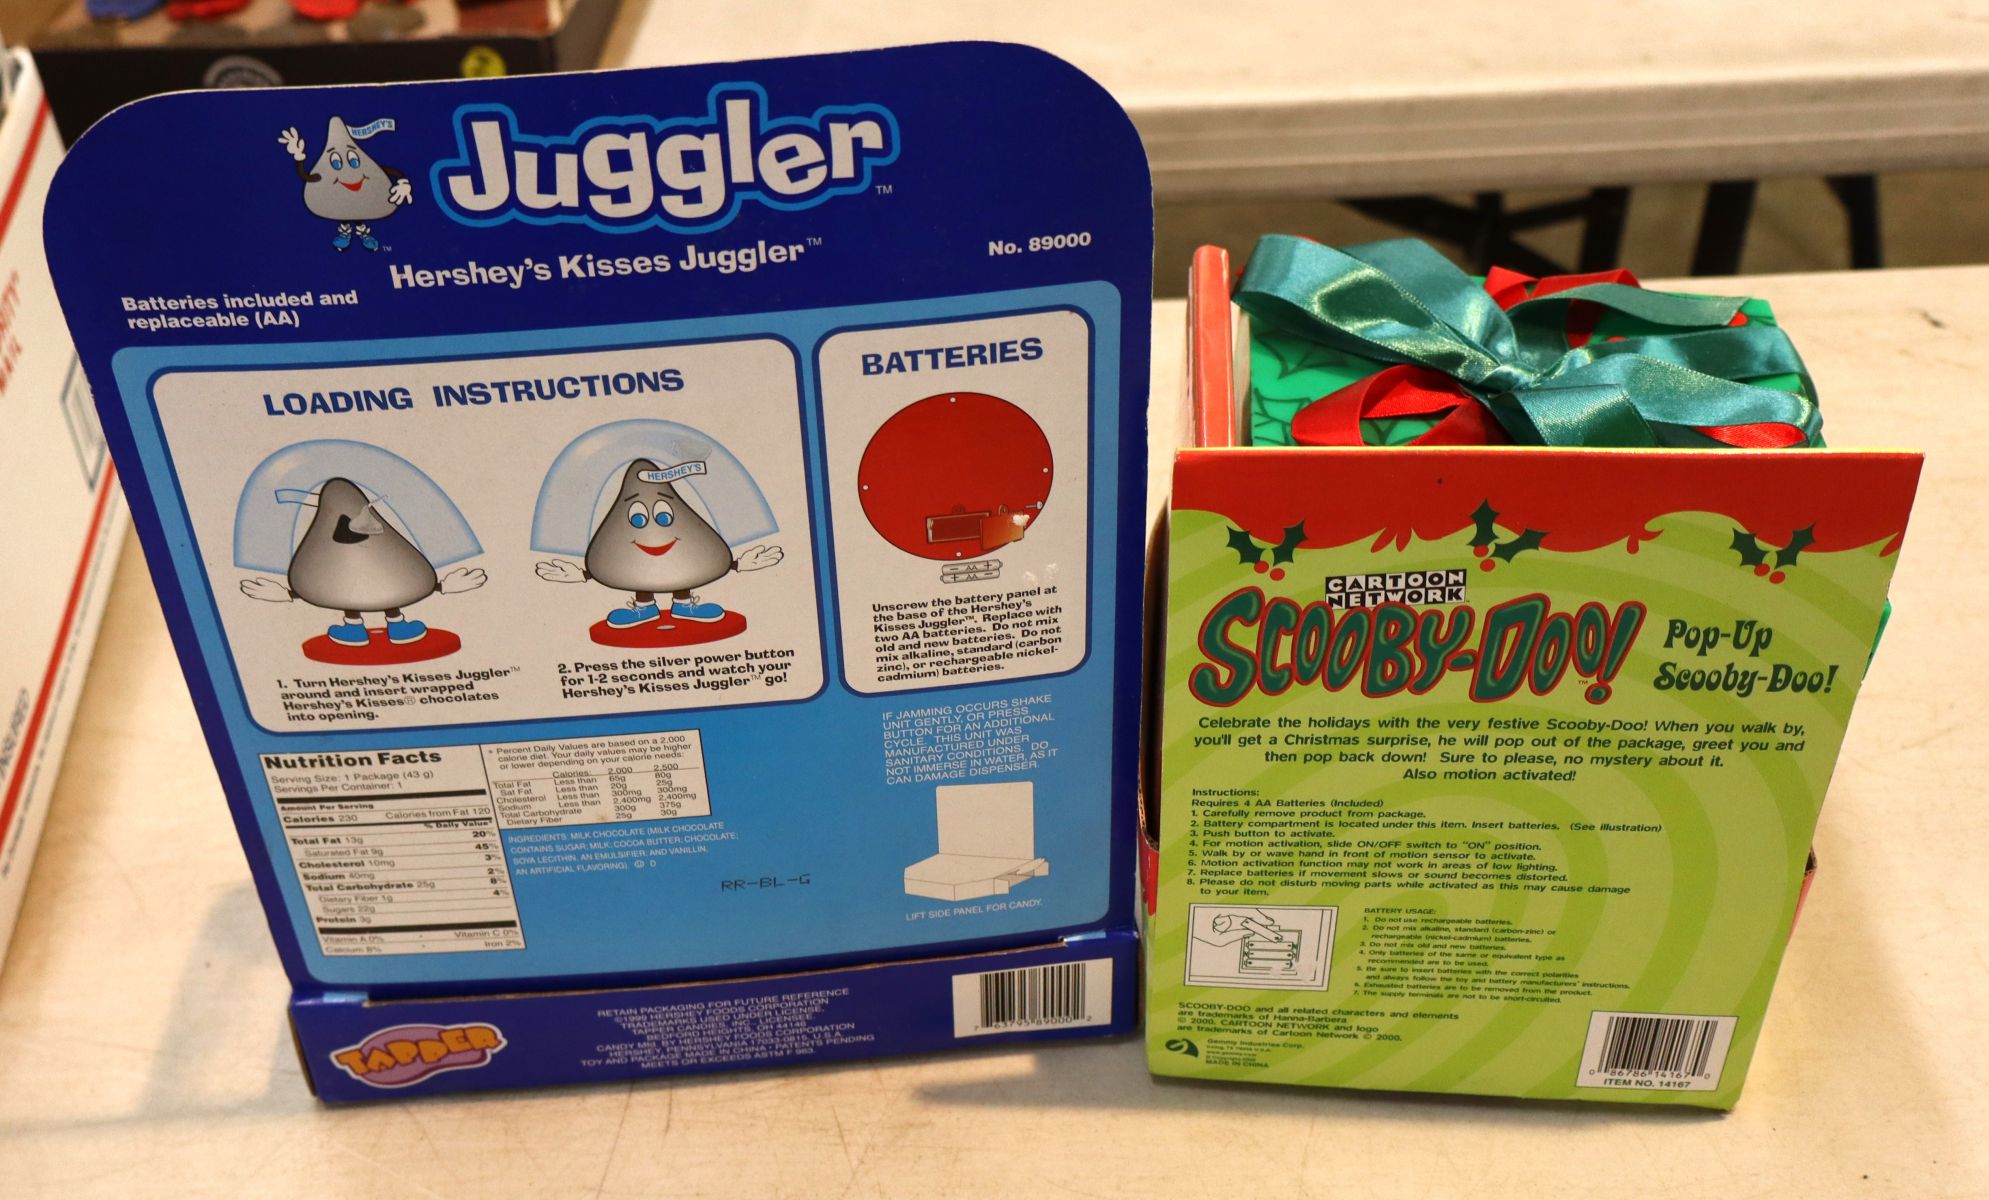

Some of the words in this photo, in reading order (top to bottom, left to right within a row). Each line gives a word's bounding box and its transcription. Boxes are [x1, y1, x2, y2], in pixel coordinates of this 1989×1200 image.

[448, 99, 883, 218] Juggler
[988, 240, 1022, 256] No.
[1028, 231, 1092, 253] 89000
[389, 257, 553, 291] Hershey's
[559, 251, 672, 281] Kisses
[121, 295, 219, 313] Batteries
[223, 292, 314, 310] included
[319, 290, 359, 306] and
[127, 312, 250, 333] replaceable
[254, 309, 301, 330] (AA)
[860, 336, 1044, 377] BATTERIES
[263, 387, 413, 417] LOADING
[431, 368, 685, 410] INSTRUCTIONS
[647, 463, 702, 481] HERSHEY'S
[1326, 569, 1466, 593] CARTOON
[871, 600, 929, 613] Unscrew
[930, 596, 952, 607] the
[953, 592, 1004, 605] battery
[1005, 585, 1041, 602] panel
[1042, 584, 1058, 595] at
[1326, 589, 1466, 609] NETWORK
[871, 612, 894, 623] the
[895, 610, 928, 621] base
[929, 606, 945, 618] of
[946, 605, 968, 616] the
[969, 597, 1033, 614] Hershey's
[1189, 586, 1647, 707] SCOOBY-DOO!
[1663, 618, 1773, 657] Pop-Up
[556, 662, 572, 674] 2.
[572, 661, 619, 673] Press
[619, 657, 646, 670] the
[647, 655, 691, 668] silver
[693, 652, 742, 668] power
[743, 647, 795, 661] button
[275, 678, 288, 689] 1.
[291, 677, 328, 689] Turn
[327, 673, 400, 688] Hershey's
[401, 672, 452, 683] Kisses
[559, 674, 585, 687] for
[586, 672, 608, 685] 1-2
[609, 667, 675, 683] seconds
[676, 664, 706, 678] and
[707, 661, 755, 676] watch
[756, 661, 792, 675] your
[560, 683, 636, 699] Hershey's
[637, 681, 690, 694] Kisses
[763, 670, 788, 687] go!
[1653, 661, 1840, 698] Scooby-Doo!
[279, 687, 332, 700] around
[333, 686, 361, 698] and
[362, 685, 408, 697] insert
[408, 679, 475, 695] wrapped
[281, 698, 354, 712] Hershey's
[418, 691, 500, 705] chocolates
[881, 710, 893, 721] IF
[895, 705, 953, 720] JAMMING
[954, 698, 1009, 714] OCCURS
[1010, 693, 1051, 707] SHAKE
[286, 711, 316, 722] into
[317, 708, 379, 723] opening.
[881, 718, 912, 731] UNIT
[913, 713, 963, 728] GENTLY,
[965, 710, 985, 722] OR
[987, 705, 1029, 719] PRESS
[1197, 715, 1271, 729] Celebrate
[1276, 715, 1302, 728] the
[1307, 715, 1371, 731] holidays
[1376, 715, 1410, 729] with
[1415, 716, 1441, 729] the
[1446, 718, 1481, 732] very
[1486, 716, 1540, 730] festive
[1545, 717, 1649, 734] Scooby-Doo!
[1654, 719, 1699, 732] When
[1703, 722, 1735, 735] you
[1740, 720, 1777, 734] walk
[1781, 721, 1805, 737] by,
[1193, 732, 1232, 748] you'll
[1237, 733, 1262, 748] get
[1267, 735, 1278, 745] a
[1283, 732, 1360, 746] Christmas
[1365, 733, 1431, 748] surprise,
[1436, 733, 1457, 746] he
[1462, 733, 1489, 746] will
[1493, 736, 1525, 749] pop
[1529, 734, 1558, 747] out
[1562, 734, 1582, 748] of
[1586, 735, 1612, 748] the
[1616, 736, 1686, 752] package,
[1691, 737, 1734, 752] greet
[1738, 740, 1770, 753] you
[1773, 739, 1806, 752] and
[263, 752, 373, 770] Nutrition
[377, 750, 443, 767] Facts
[1263, 749, 1297, 762] then
[1302, 752, 1333, 765] pop
[1337, 750, 1375, 763] back
[1380, 750, 1427, 763] down!
[1438, 750, 1475, 763] Sure
[1480, 751, 1498, 764] to
[1502, 751, 1557, 767] please,
[1562, 754, 1584, 765] no
[1589, 753, 1653, 769] mystery
[1657, 754, 1704, 767] about
[1708, 754, 1724, 767] it.
[270, 775, 312, 786] Serving
[314, 774, 338, 783] Size:
[353, 772, 400, 783] Package
[402, 771, 420, 780] (43
[421, 770, 434, 780] g)
[1401, 767, 1438, 780] Also
[1442, 767, 1497, 780] motion
[1501, 768, 1577, 782] activated!
[1190, 797, 1240, 808] Requires
[1242, 798, 1251, 807] 4
[1254, 798, 1272, 807] AA
[1275, 798, 1326, 807] Batteries
[1329, 798, 1384, 808] (Included)
[1191, 787, 1260, 797] Instructions:
[1190, 808, 1198, 817] 1.
[1201, 808, 1250, 819] Carefully
[1253, 809, 1296, 818] remove
[1299, 808, 1343, 819] product
[1346, 808, 1374, 818] from
[1376, 809, 1426, 820] package.
[1188, 828, 1199, 837] 3.
[1201, 828, 1230, 837] Push
[1233, 828, 1270, 838] button
[1273, 829, 1286, 838] to
[1289, 828, 1336, 838] activate.
[721, 873, 811, 893] RR-BL-G
[904, 911, 927, 922] LIFT
[927, 908, 951, 920] SIDE
[952, 905, 984, 917] PANEL
[985, 902, 1008, 913] FOR
[1363, 907, 1403, 915] BATTERY
[334, 1026, 503, 1075] TAPPER
[1603, 1077, 1632, 1087] ITEM
[1634, 1079, 1655, 1088] NO.
[1658, 1080, 1692, 1089] 14167
[1609, 1069, 1648, 1078] 86786
[1655, 1071, 1691, 1080] 14167
